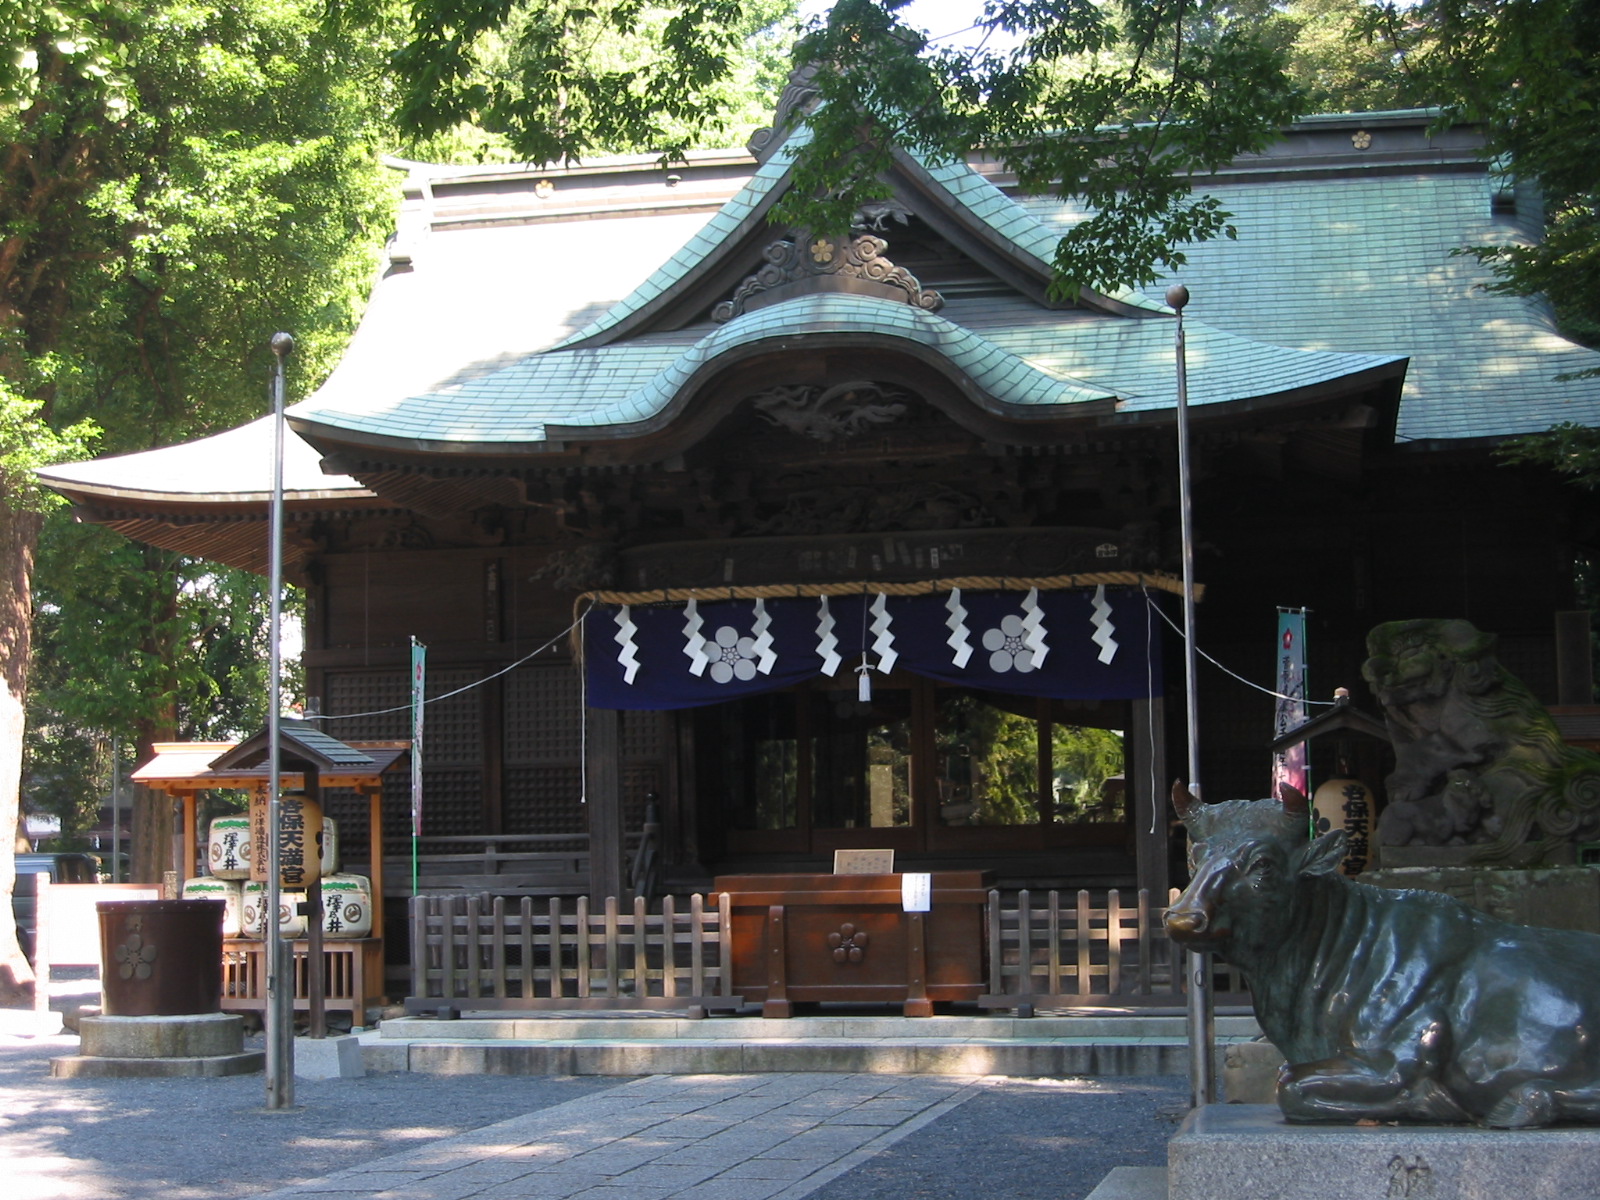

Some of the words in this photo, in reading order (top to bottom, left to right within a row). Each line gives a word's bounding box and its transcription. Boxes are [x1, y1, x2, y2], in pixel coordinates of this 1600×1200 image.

[279, 800, 305, 883] 谷保天満宮
[1342, 784, 1369, 875] 谷保天満宮
